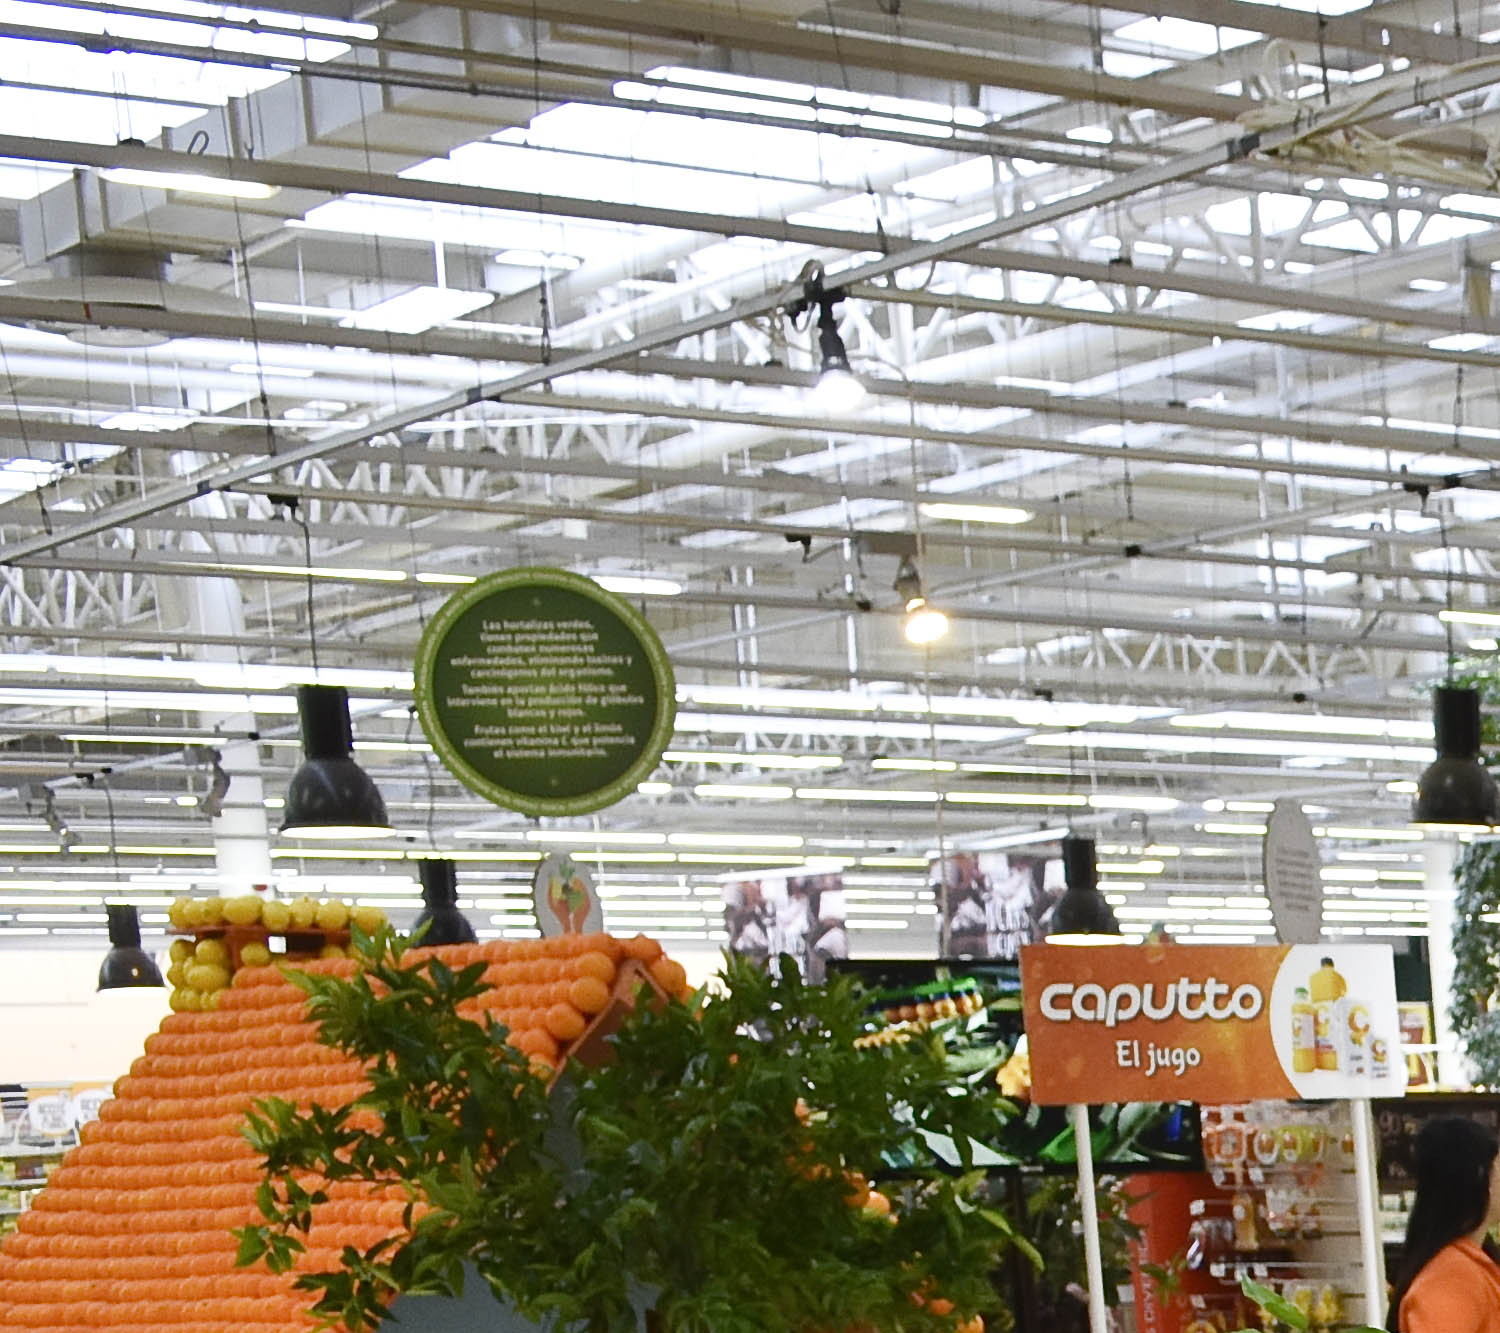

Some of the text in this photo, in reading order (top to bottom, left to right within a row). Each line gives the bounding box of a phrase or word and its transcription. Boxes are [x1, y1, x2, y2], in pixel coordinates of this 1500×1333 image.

[1040, 977, 1263, 1028] caputto
[1116, 1040, 1201, 1075] El jugo
